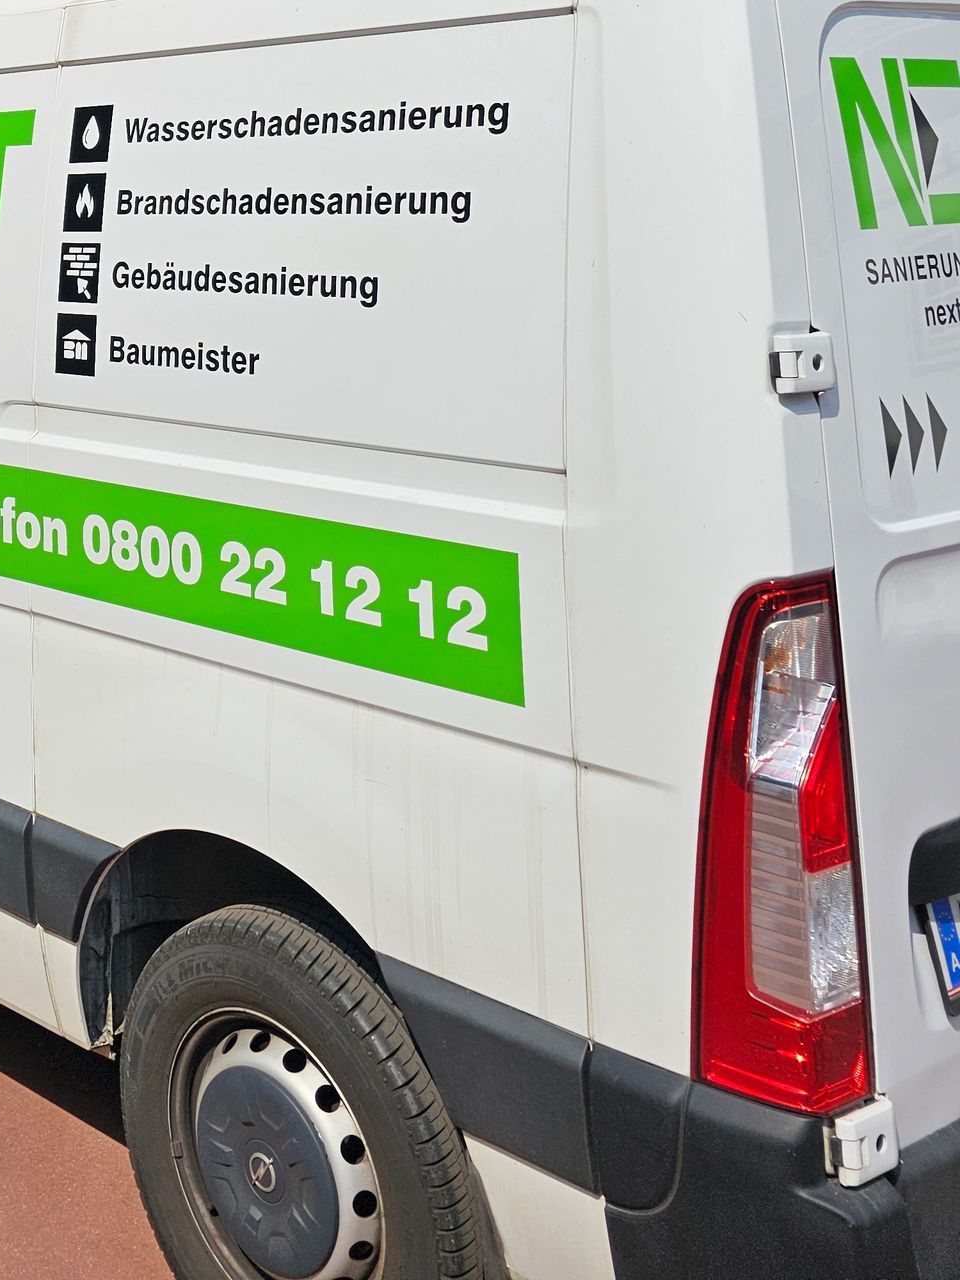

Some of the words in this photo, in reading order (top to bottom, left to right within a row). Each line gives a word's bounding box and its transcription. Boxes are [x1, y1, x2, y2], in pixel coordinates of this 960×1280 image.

[125, 101, 510, 143] Wasserschadensanierung
[116, 185, 472, 223] Brandschadensanierung
[111, 261, 379, 308] Gebäudesanierung
[109, 335, 260, 375] Baumeister
[82, 514, 203, 586] 0800
[220, 542, 287, 606] 22
[310, 559, 383, 627] 12
[408, 579, 489, 652] 12
